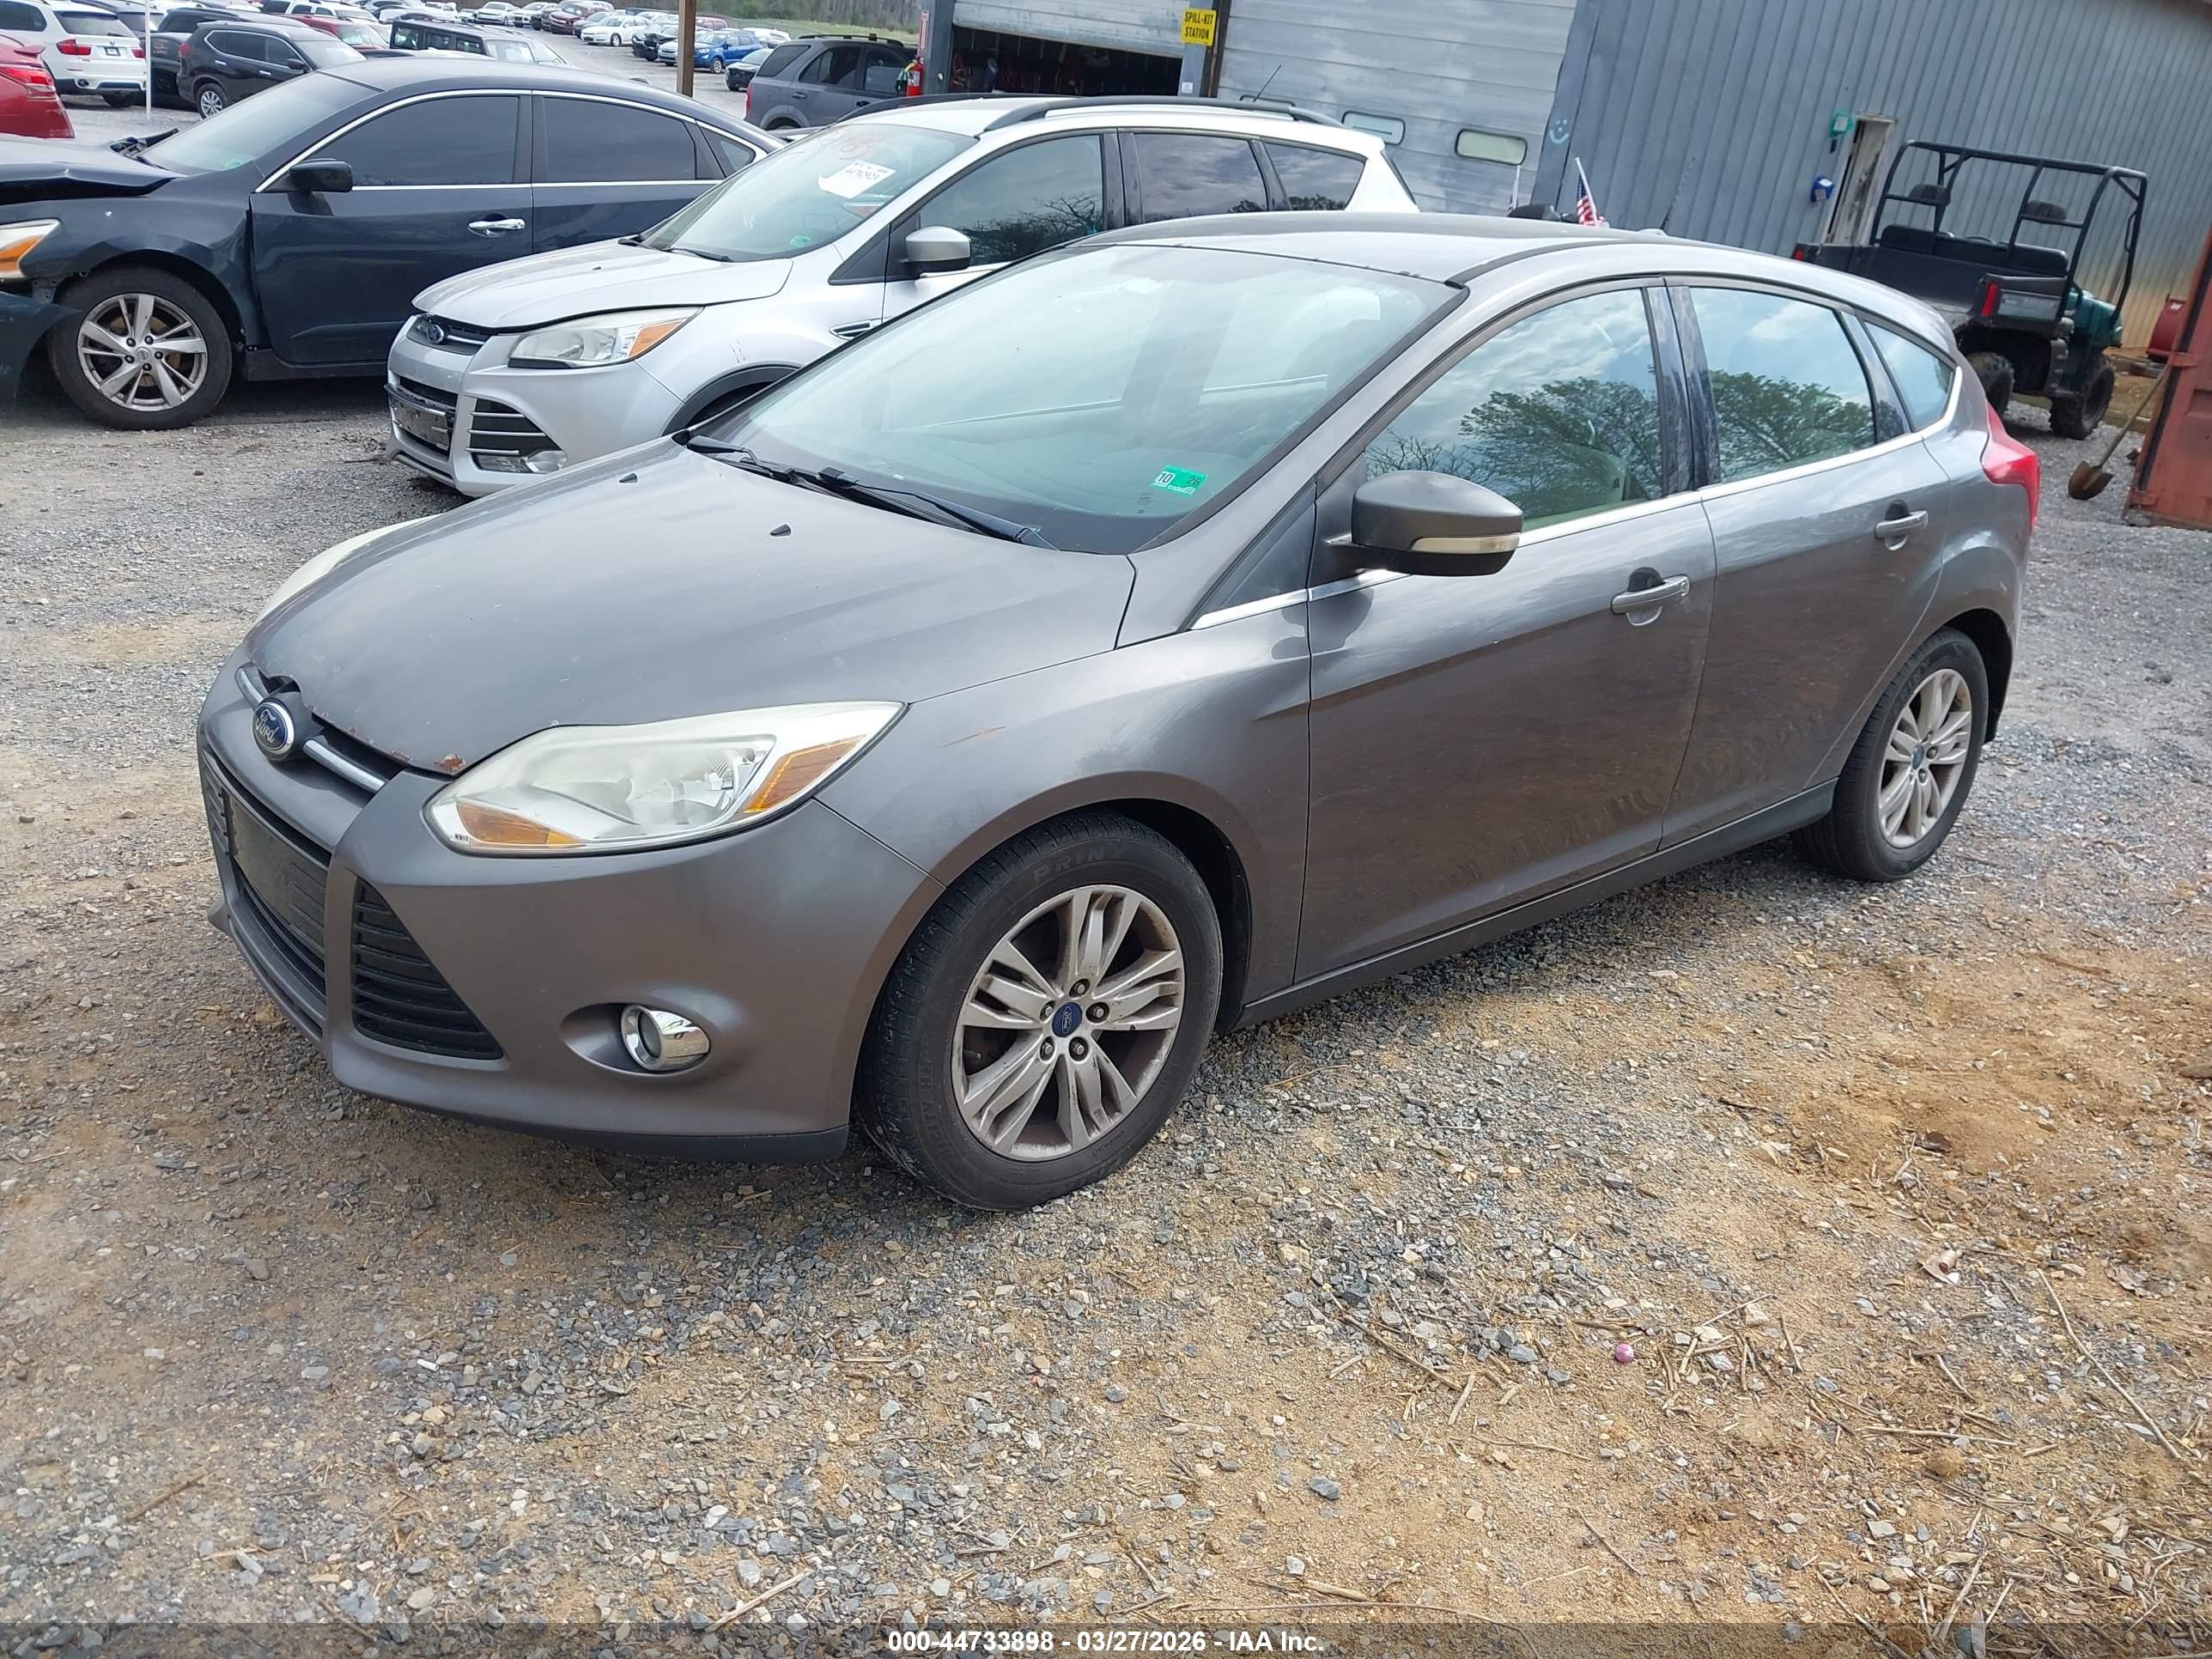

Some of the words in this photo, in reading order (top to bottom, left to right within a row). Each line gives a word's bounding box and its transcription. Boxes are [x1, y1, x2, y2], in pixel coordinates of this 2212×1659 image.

[1185, 27, 1209, 40] STATION
[1158, 473, 1173, 483] 10
[255, 708, 280, 744] Ford
